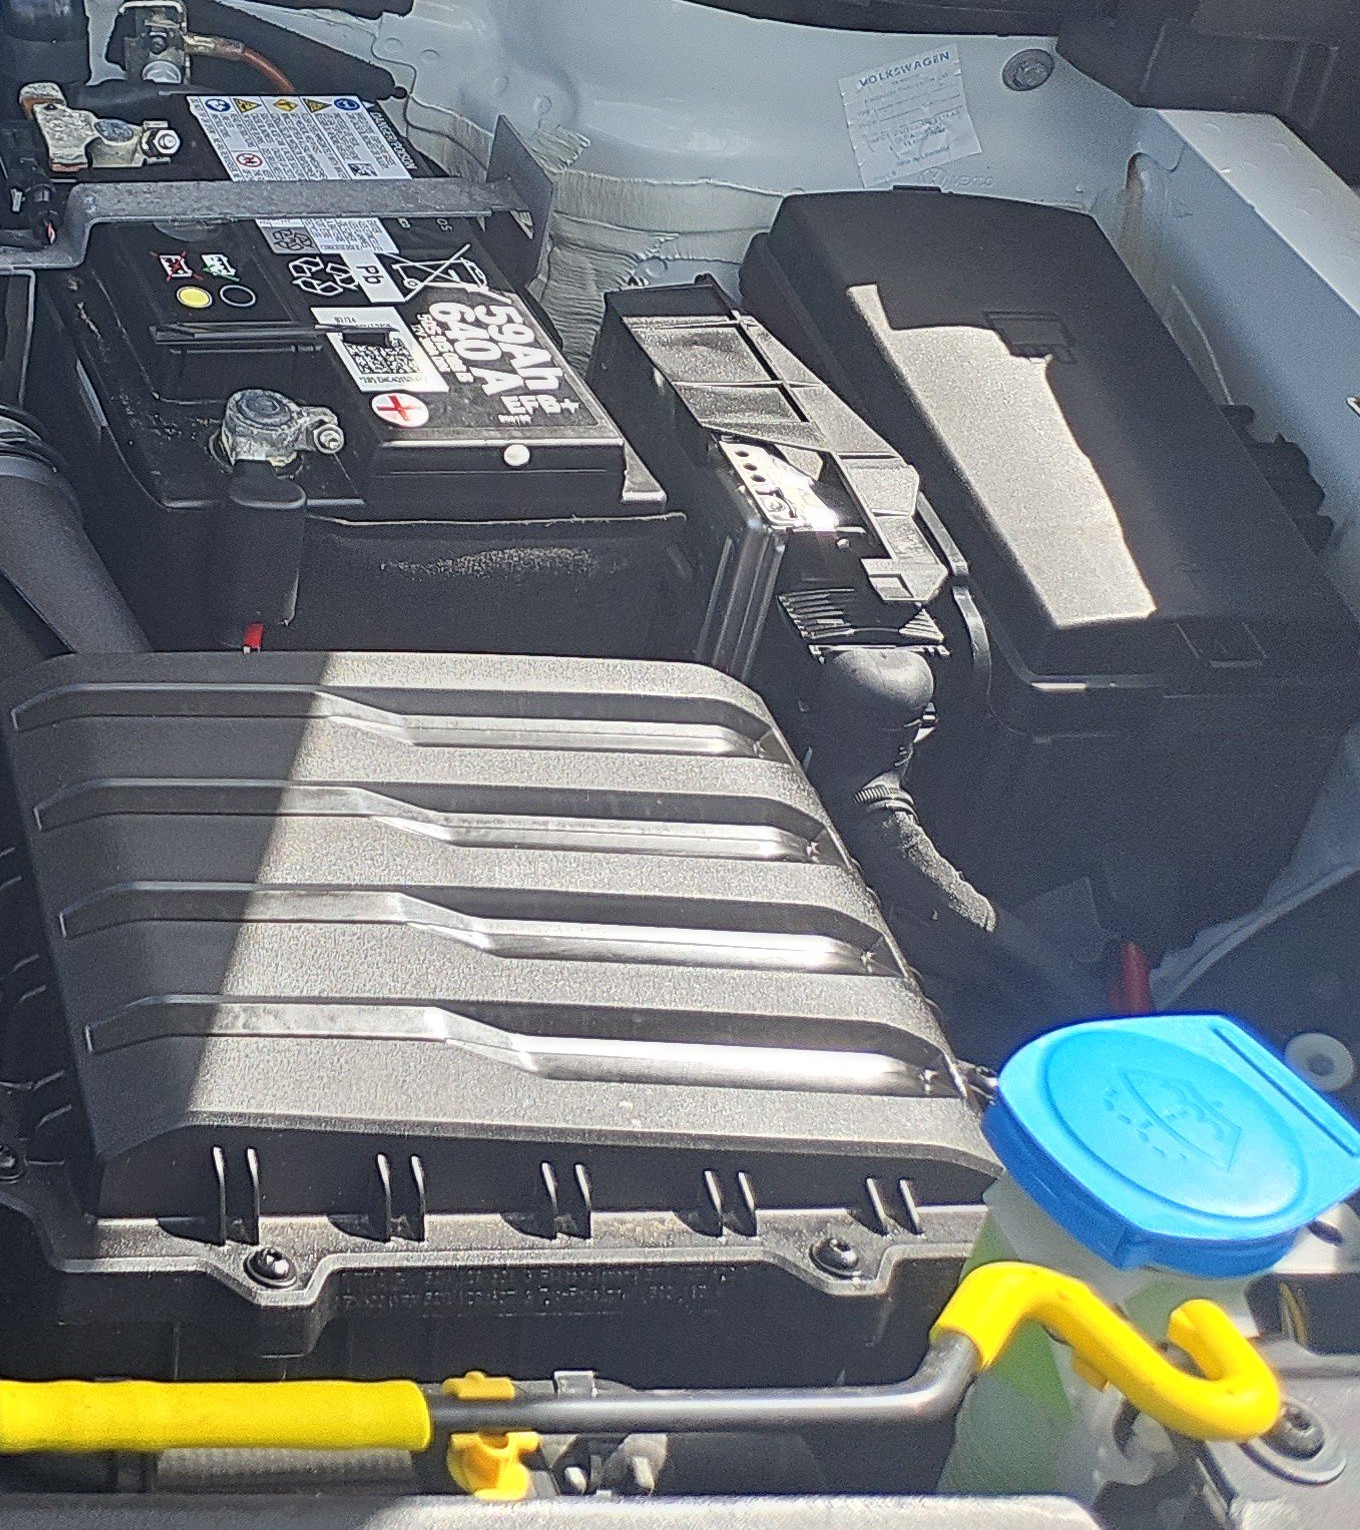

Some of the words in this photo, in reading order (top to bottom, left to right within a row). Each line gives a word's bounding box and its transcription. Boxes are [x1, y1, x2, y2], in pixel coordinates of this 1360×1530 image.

[858, 51, 950, 87] VOLKSWAGEN
[356, 265, 382, 285] Pb
[429, 301, 503, 361] 640
[472, 366, 524, 396] A
[473, 304, 563, 391] 59Ah
[500, 394, 580, 415] EFB+
